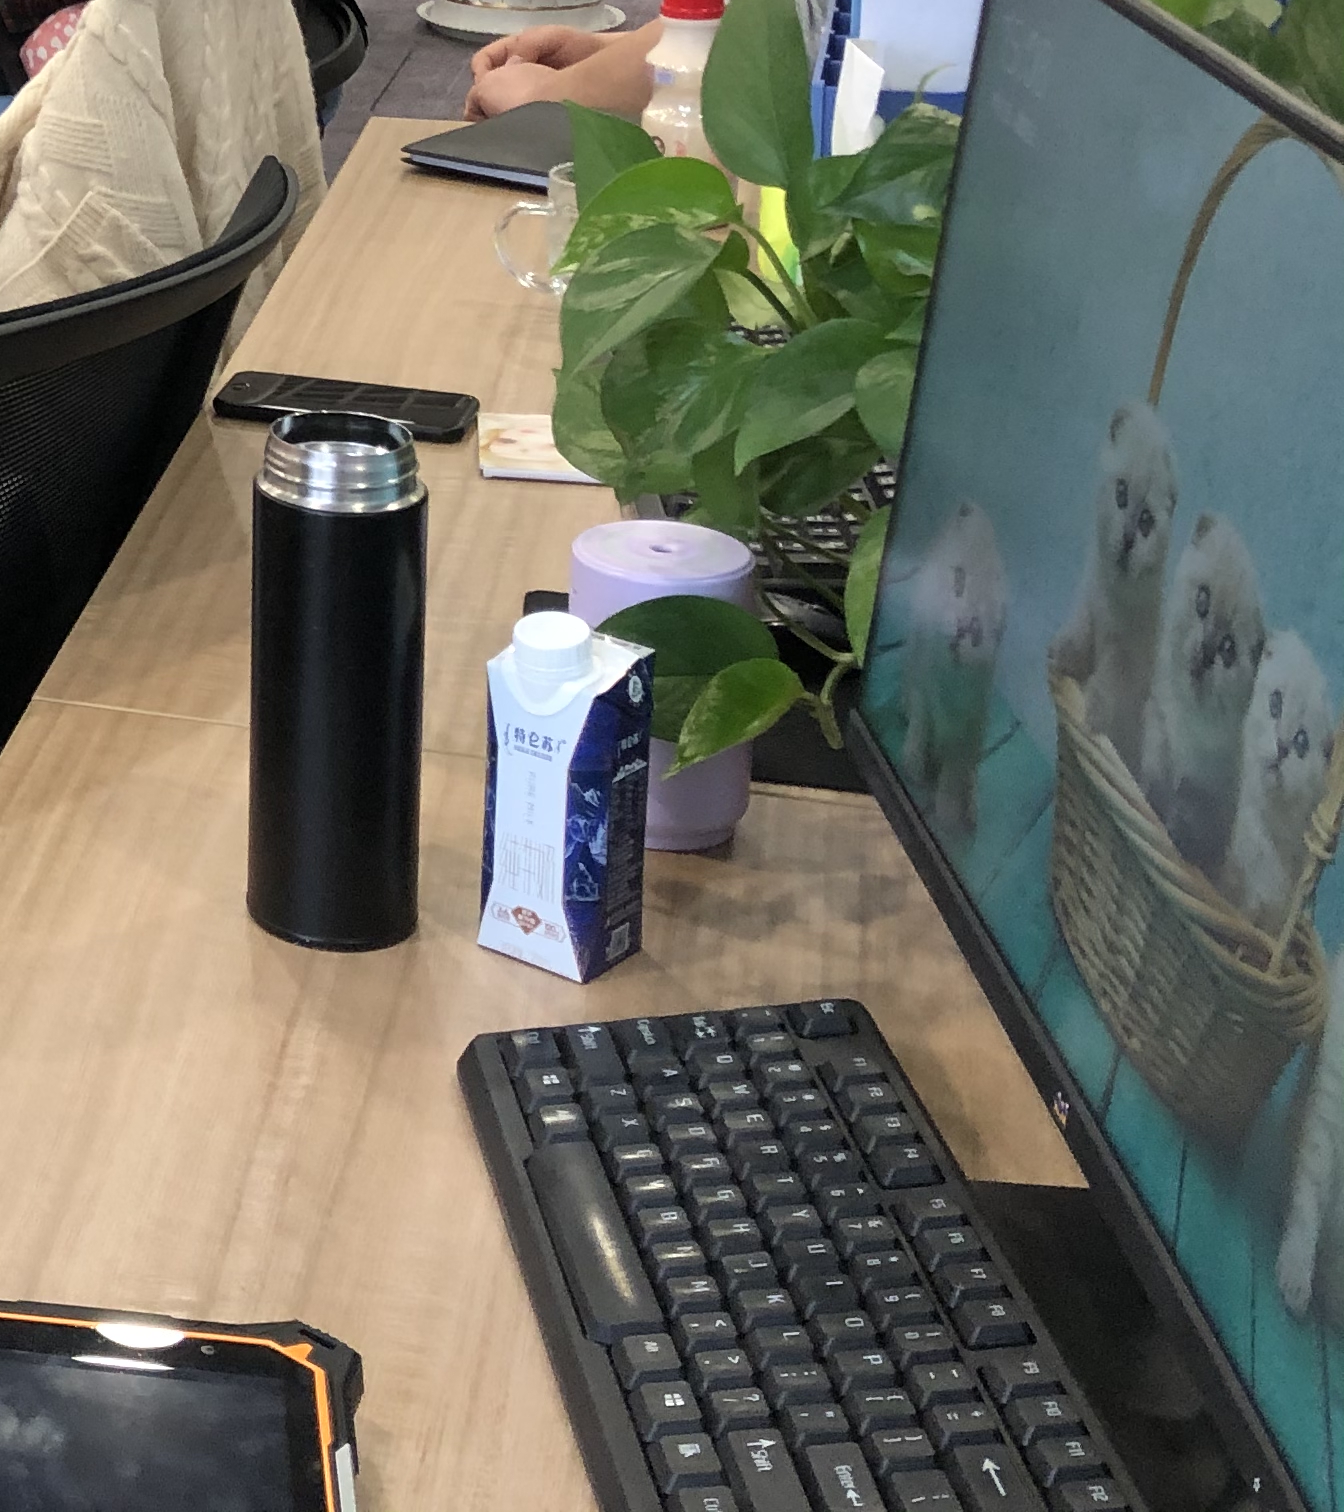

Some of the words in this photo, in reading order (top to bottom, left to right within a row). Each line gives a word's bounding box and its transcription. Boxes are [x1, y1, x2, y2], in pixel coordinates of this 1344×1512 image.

[514, 727, 553, 752] 特仑苏
[497, 832, 555, 904] 纯牛奶
[662, 1069, 678, 1077] A
[733, 1084, 750, 1094] W
[867, 1088, 884, 1097] F2
[675, 1098, 692, 1107] S
[621, 1118, 639, 1127] X
[746, 1114, 764, 1122] E
[885, 1117, 901, 1128] F3
[760, 1145, 778, 1154] R
[716, 1190, 733, 1199] G
[930, 1198, 946, 1208] F5
[660, 1212, 677, 1220] B
[792, 1209, 810, 1218] Y
[733, 1223, 750, 1233] H
[807, 1244, 825, 1253] U
[749, 1260, 767, 1268] J
[970, 1268, 987, 1279] F7
[766, 1294, 785, 1304] K
[783, 1331, 800, 1340] L
[863, 1355, 882, 1364] P
[1022, 1362, 1040, 1374] F9
[1042, 1402, 1062, 1416] F10
[1065, 1441, 1085, 1456] F11
[750, 1450, 773, 1472] Shift
[1088, 1485, 1108, 1501] F12
